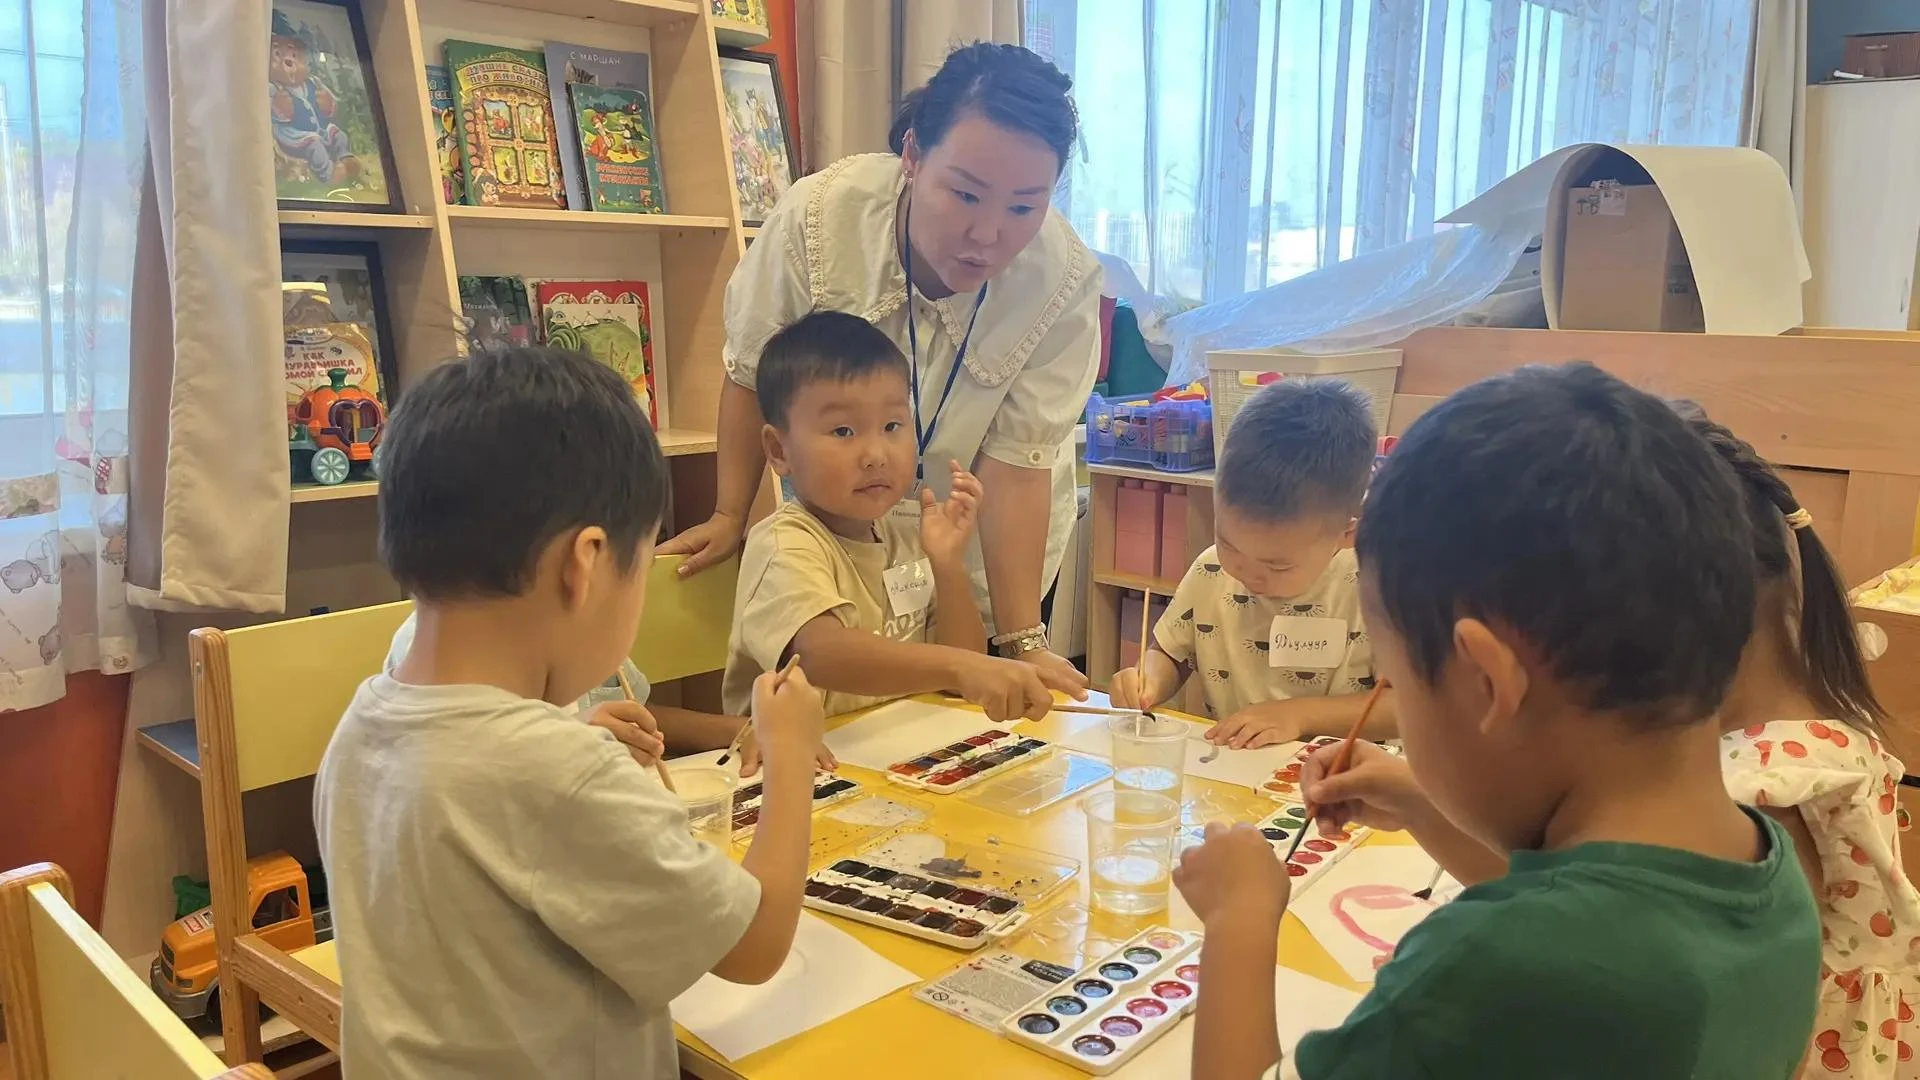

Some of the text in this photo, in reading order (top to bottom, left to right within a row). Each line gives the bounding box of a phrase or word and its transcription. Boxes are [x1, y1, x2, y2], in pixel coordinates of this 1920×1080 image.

[465, 62, 547, 81] ЛУЧШИЕ СКАЗК
[470, 73, 490, 84] ПРО
[303, 351, 326, 361] КАК
